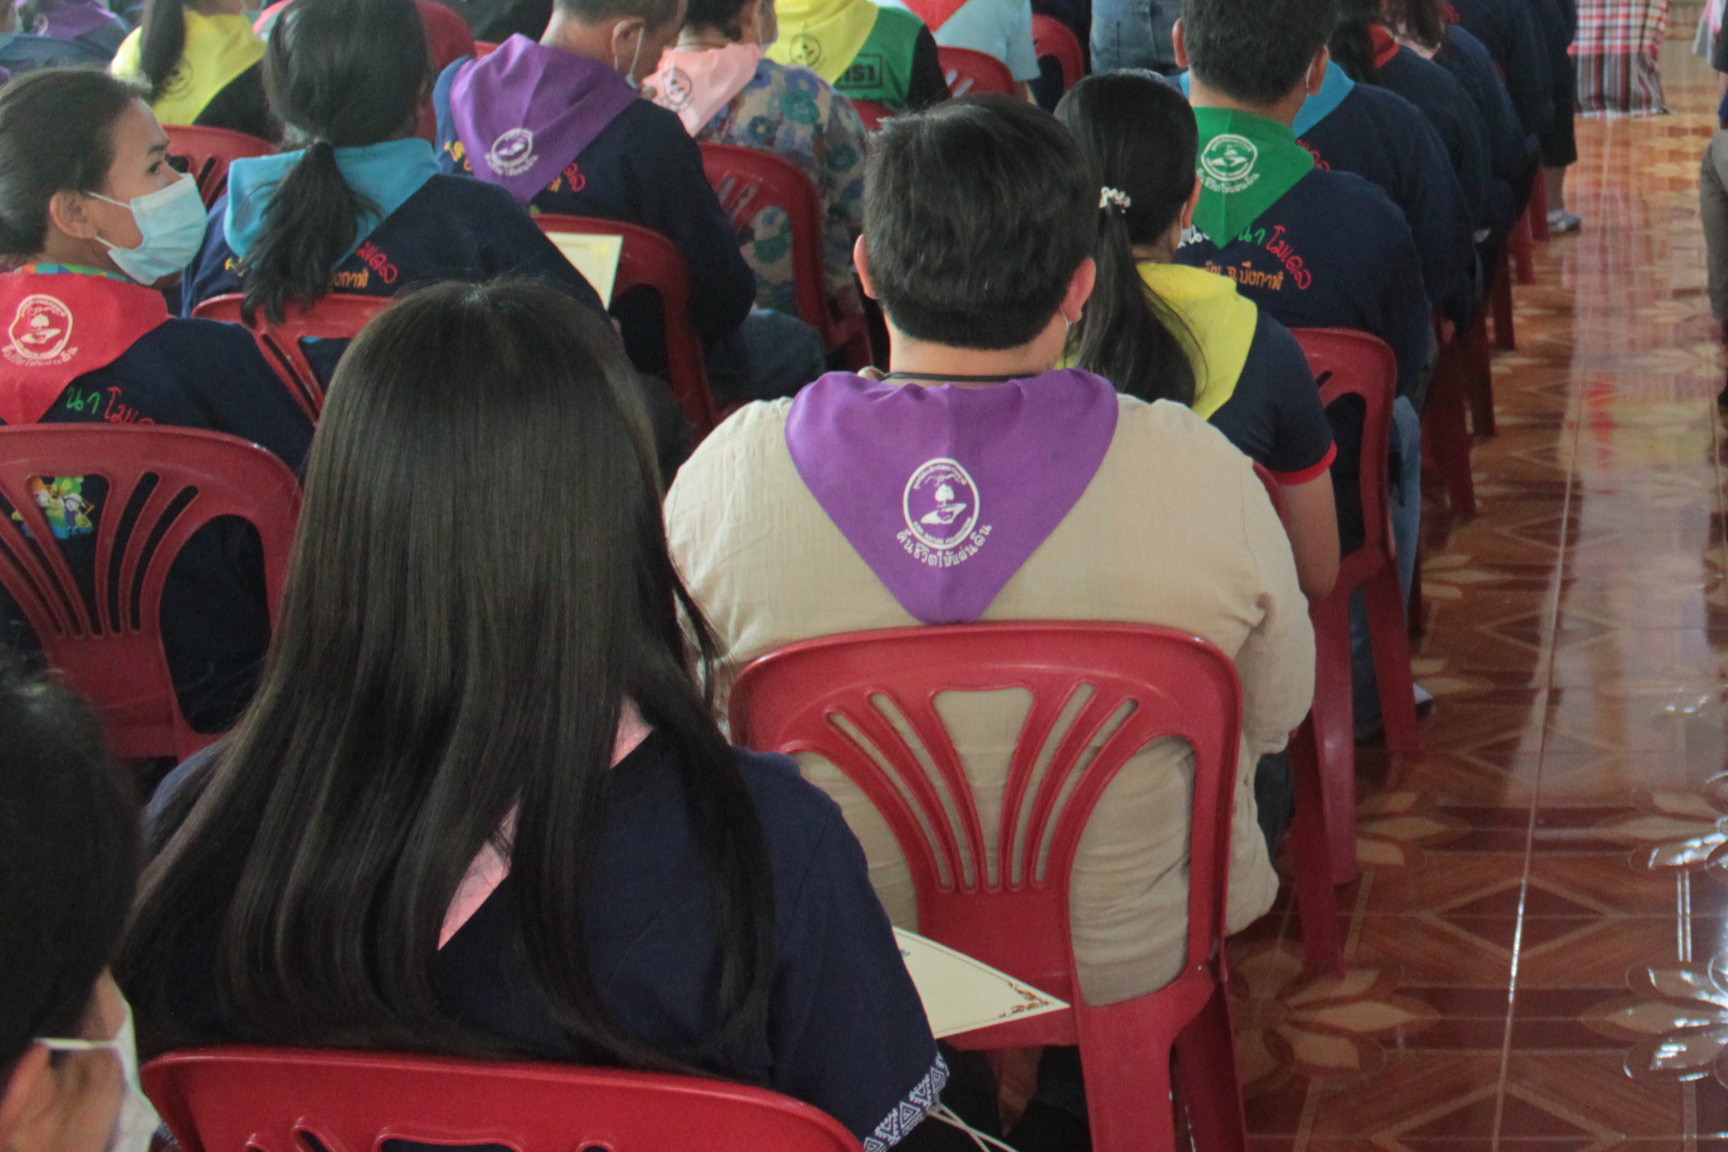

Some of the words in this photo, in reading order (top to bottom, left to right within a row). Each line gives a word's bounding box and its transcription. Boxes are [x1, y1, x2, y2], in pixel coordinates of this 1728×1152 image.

[896, 524, 993, 568] คืนชีวิตให้แผ่นดิน
